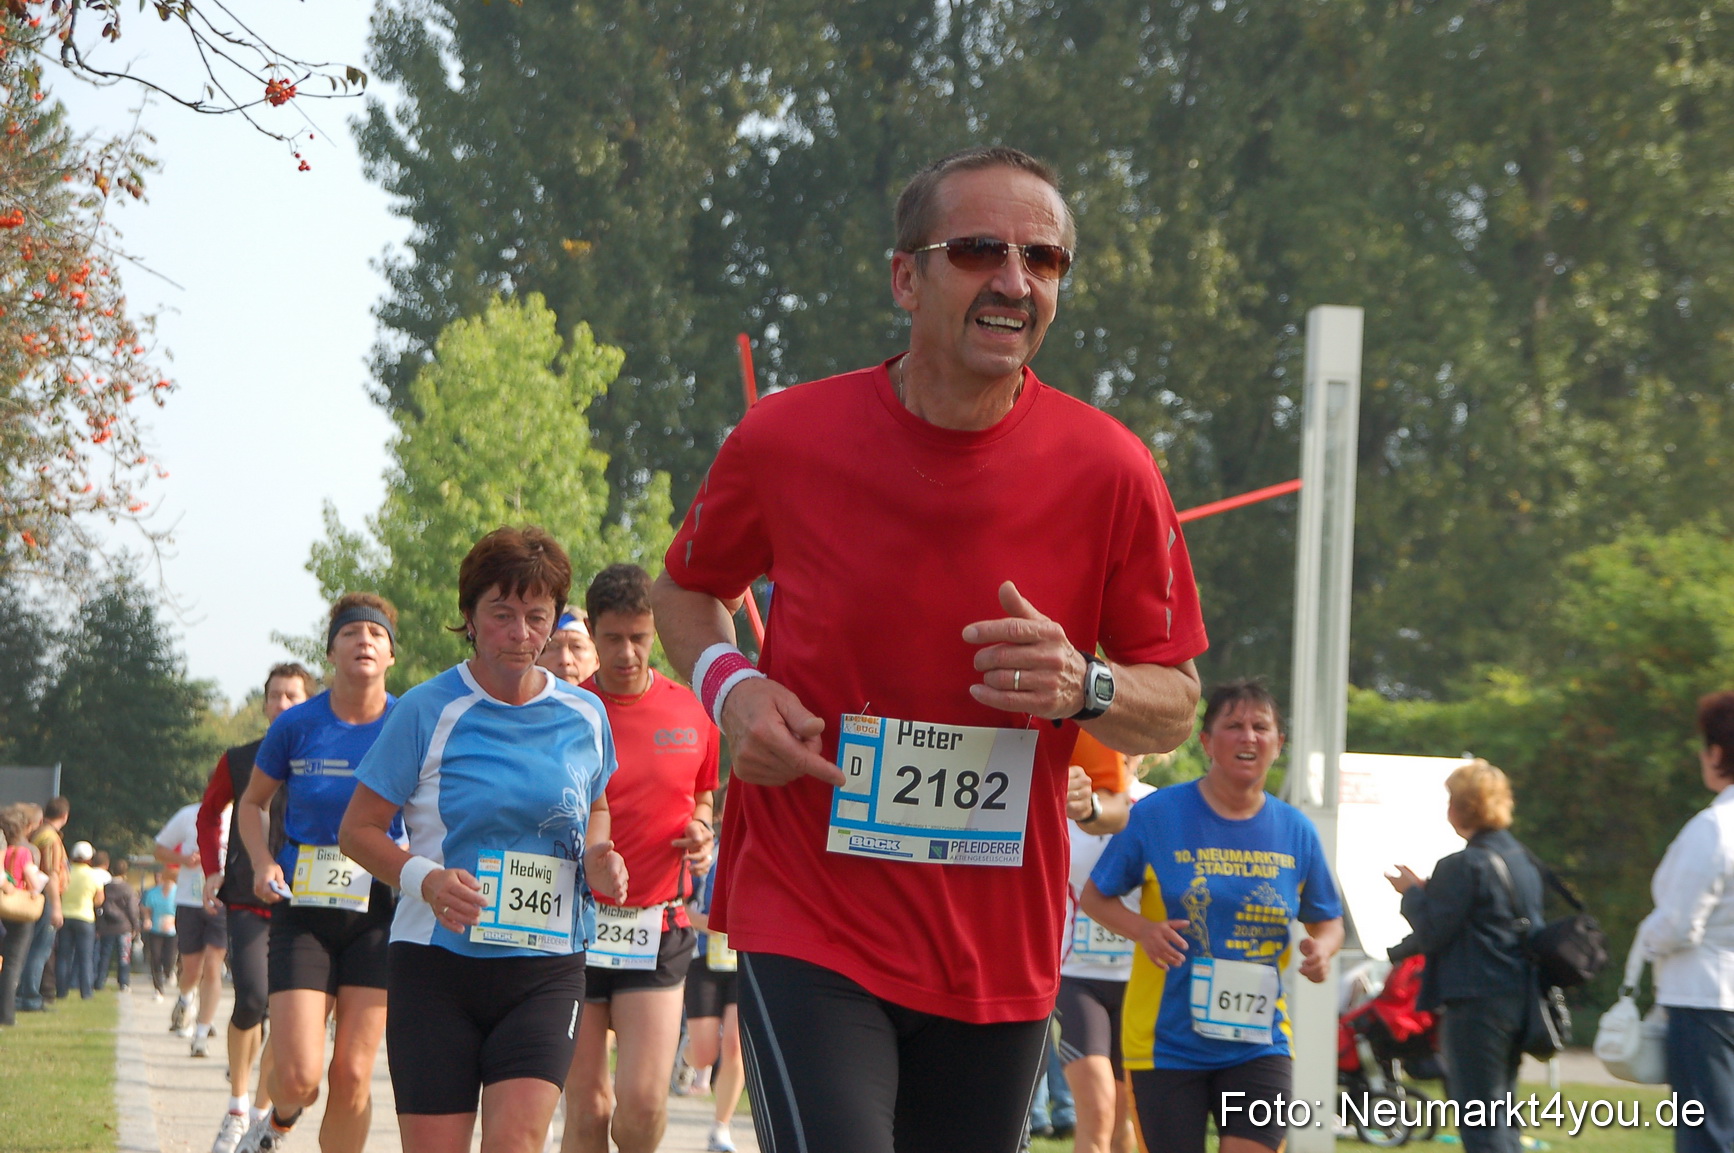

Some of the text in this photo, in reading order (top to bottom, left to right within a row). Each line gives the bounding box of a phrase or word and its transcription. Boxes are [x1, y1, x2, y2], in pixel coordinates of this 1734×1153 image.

[653, 727, 698, 747] eco
[897, 720, 963, 750] Peter
[850, 756, 862, 776] D
[892, 765, 1009, 810] 2182
[849, 834, 901, 851] BOCK
[950, 841, 1020, 854] PFLEIDERER
[1174, 847, 1296, 869] 10. NEUMARKTER
[327, 869, 352, 887] 25
[510, 858, 552, 884] Hedwig
[1194, 862, 1280, 879] STADTLAUF
[482, 882, 490, 895] D
[508, 887, 562, 917] 3461
[599, 903, 639, 919] Michael
[596, 923, 649, 945] 2343
[1218, 990, 1268, 1014] 6172
